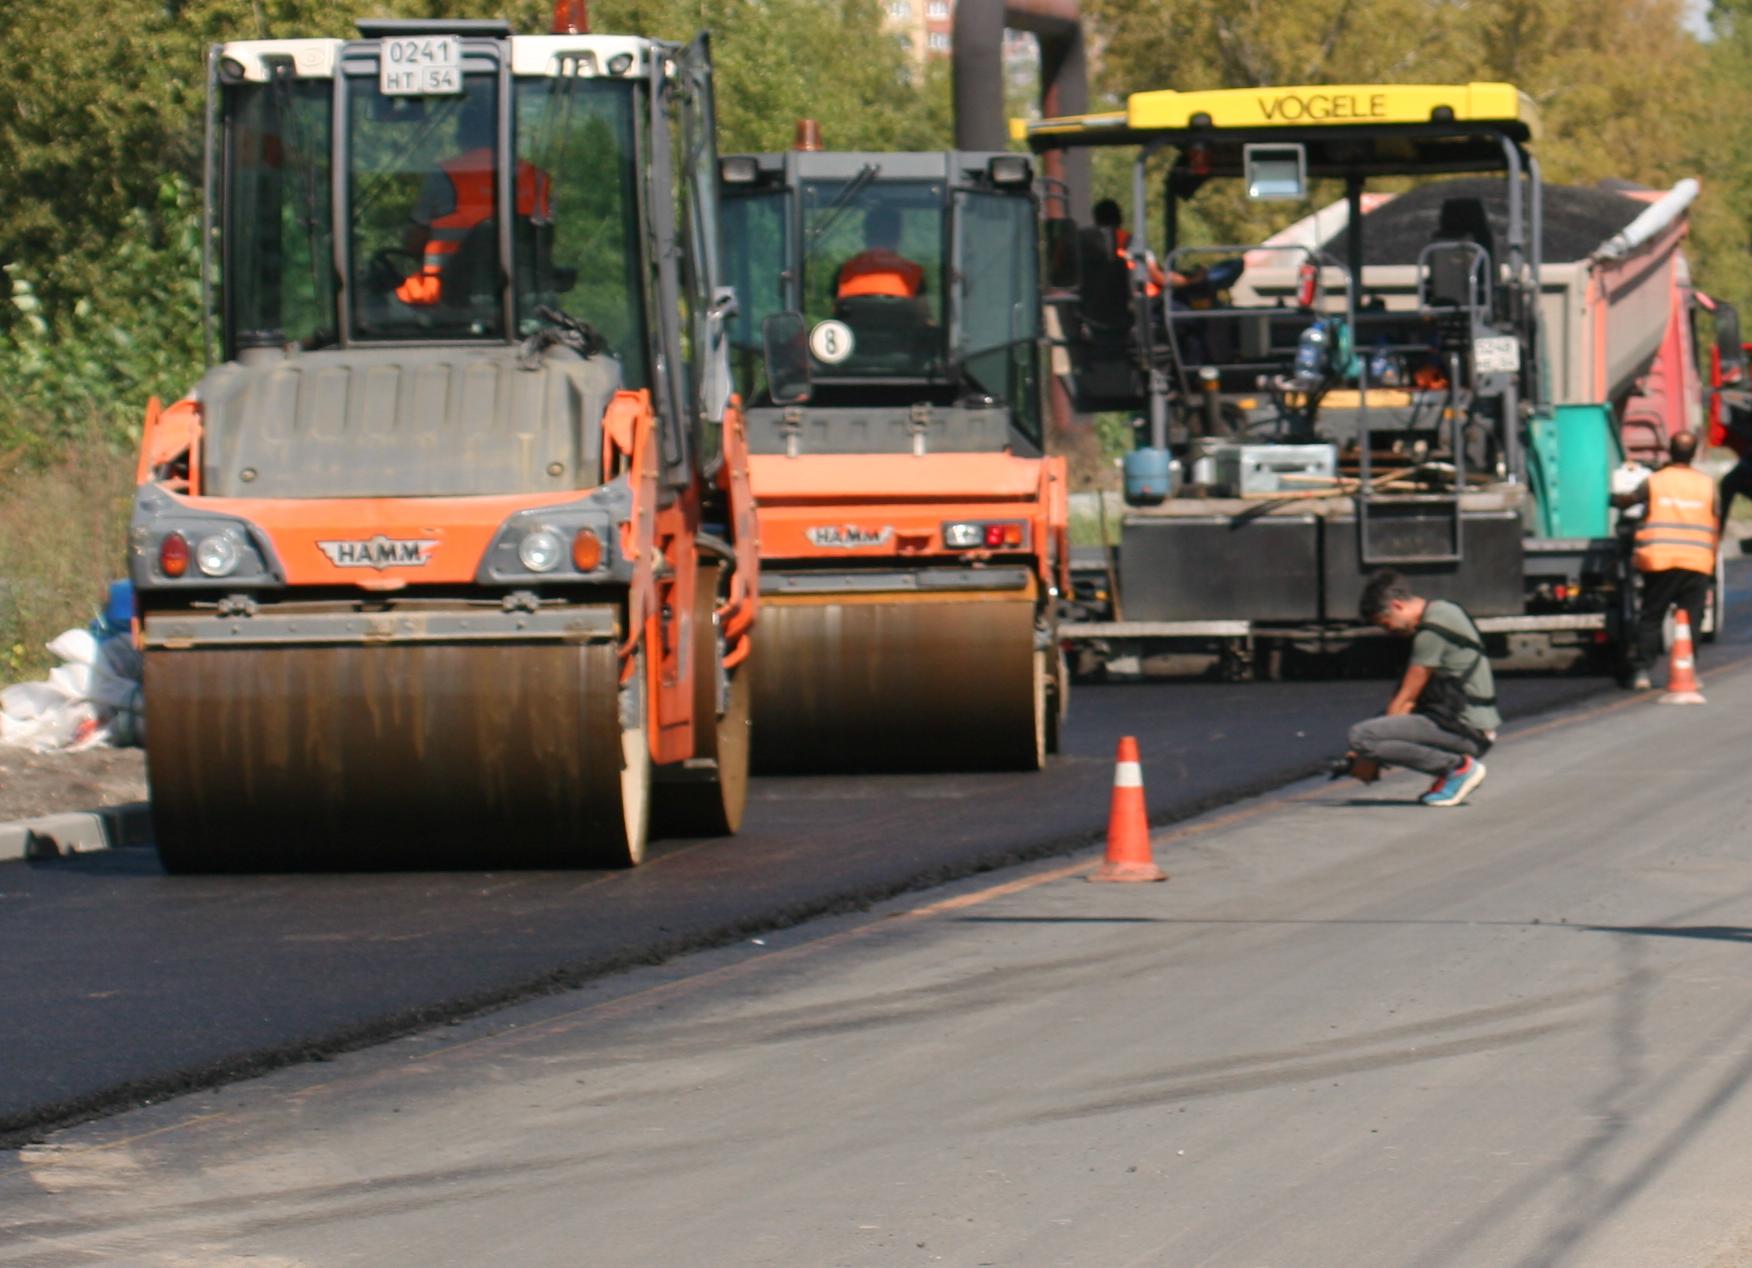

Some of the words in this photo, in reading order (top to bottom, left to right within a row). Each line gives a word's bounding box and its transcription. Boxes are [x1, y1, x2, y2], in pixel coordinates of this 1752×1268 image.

[389, 39, 449, 63] 0241
[429, 70, 453, 88] 54
[824, 328, 837, 355] 8
[816, 527, 880, 543] HAMM
[336, 542, 420, 562] HAMM
